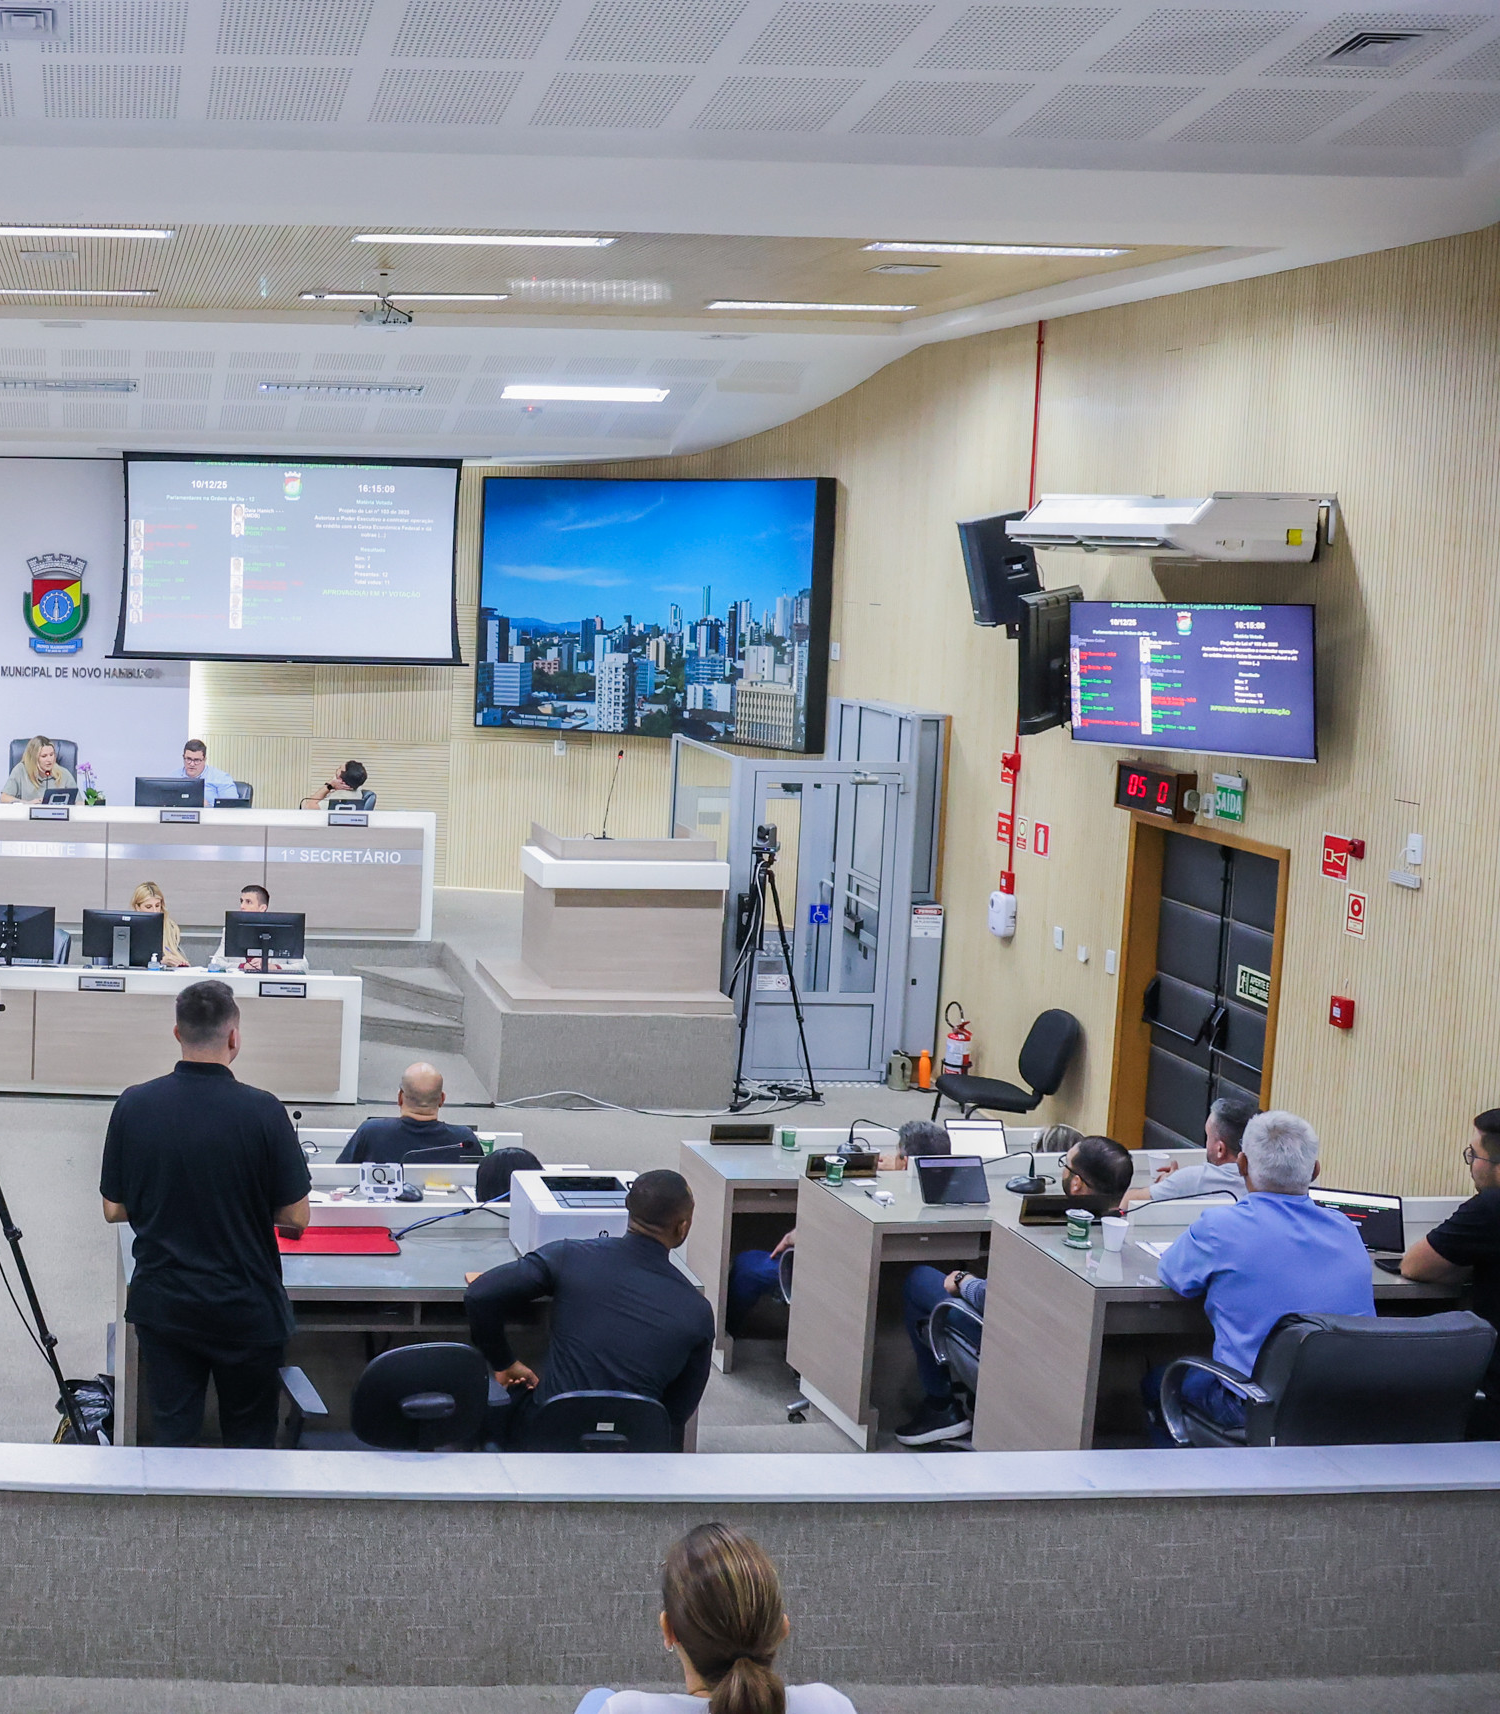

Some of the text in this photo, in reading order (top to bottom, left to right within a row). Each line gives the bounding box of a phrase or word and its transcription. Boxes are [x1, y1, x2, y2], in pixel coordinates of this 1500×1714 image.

[191, 480, 228, 489] 10/12/25
[358, 484, 395, 493] 16:15:09
[1, 666, 52, 678] MUNICIPAL
[56, 667, 68, 678] DE
[72, 667, 102, 679] NOVO
[1127, 774, 1148, 798] 05
[1216, 789, 1242, 816] SAÍDA
[300, 848, 401, 864] SECRETÁRIO
[1250, 976, 1270, 991] APERTE E
[1249, 985, 1268, 1000] EMPURRE
